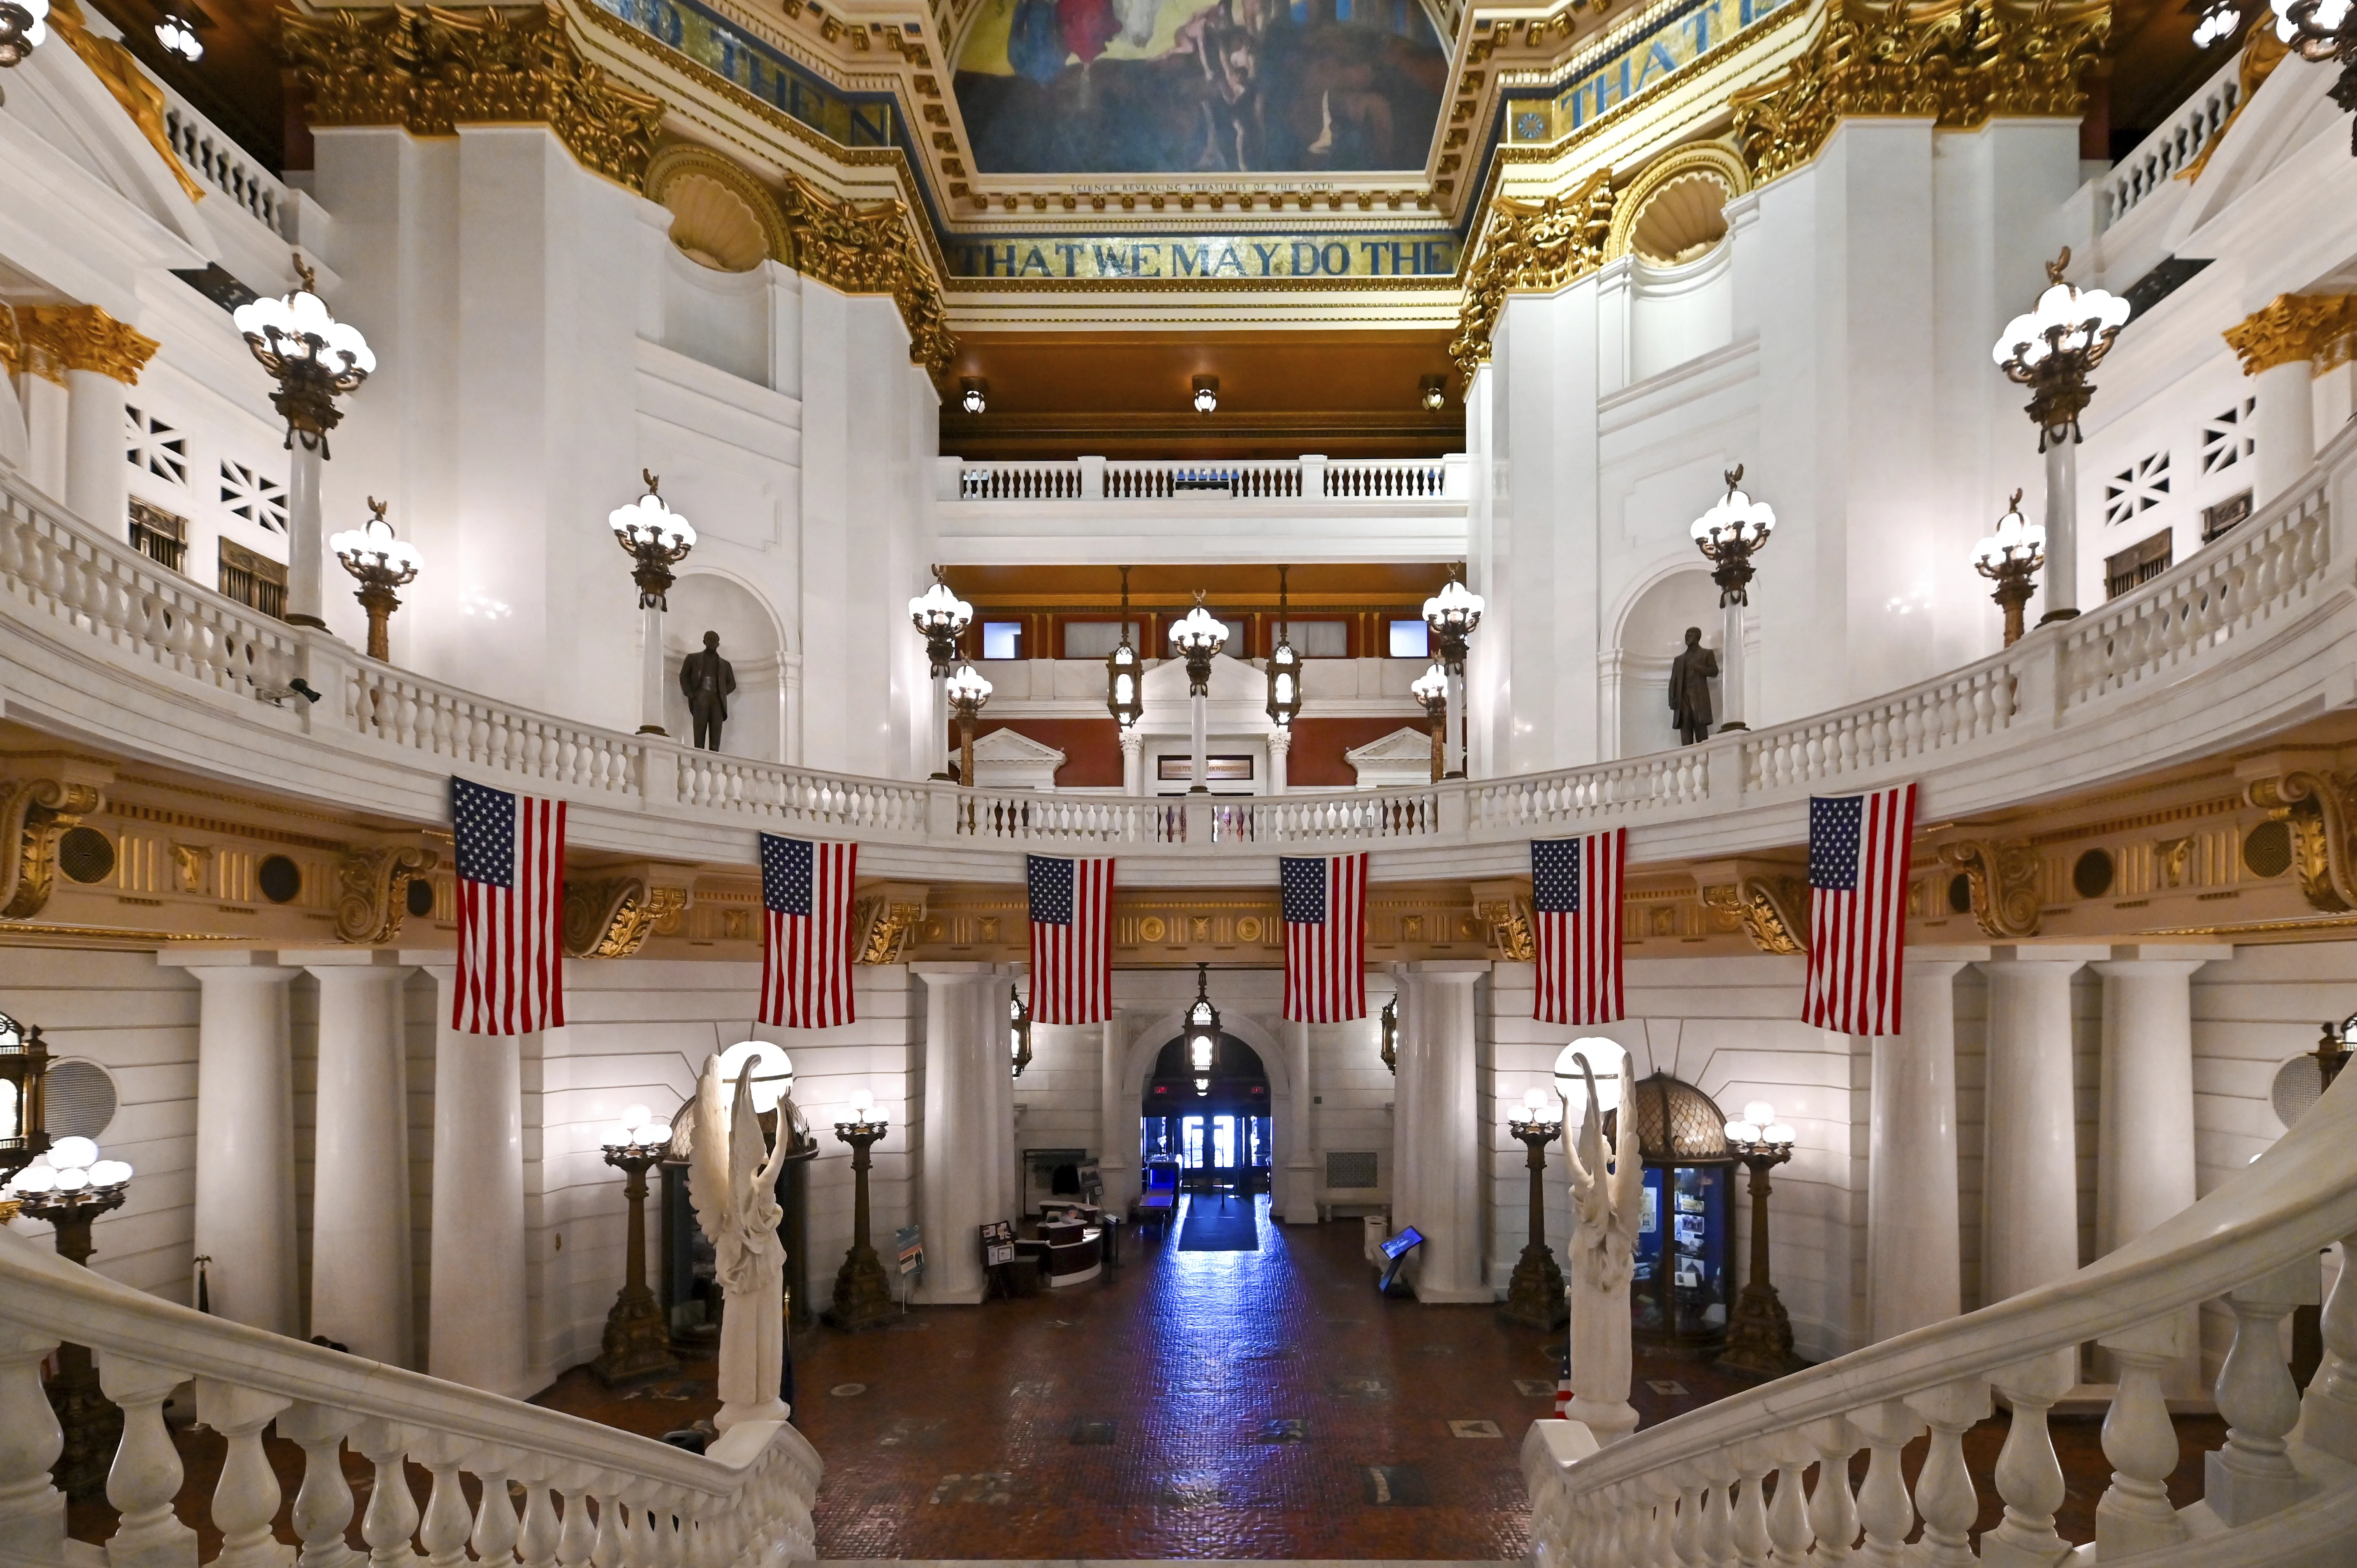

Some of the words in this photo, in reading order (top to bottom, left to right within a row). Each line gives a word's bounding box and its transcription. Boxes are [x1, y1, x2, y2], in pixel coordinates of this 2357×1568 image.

[708, 28, 825, 134] THE
[851, 109, 887, 147] N
[1561, 0, 1721, 131] THAT
[956, 243, 1085, 277] THAT
[1092, 243, 1161, 277] WE
[1172, 243, 1283, 277] MAY
[1291, 243, 1351, 276] DO
[1360, 241, 1454, 276] THE
